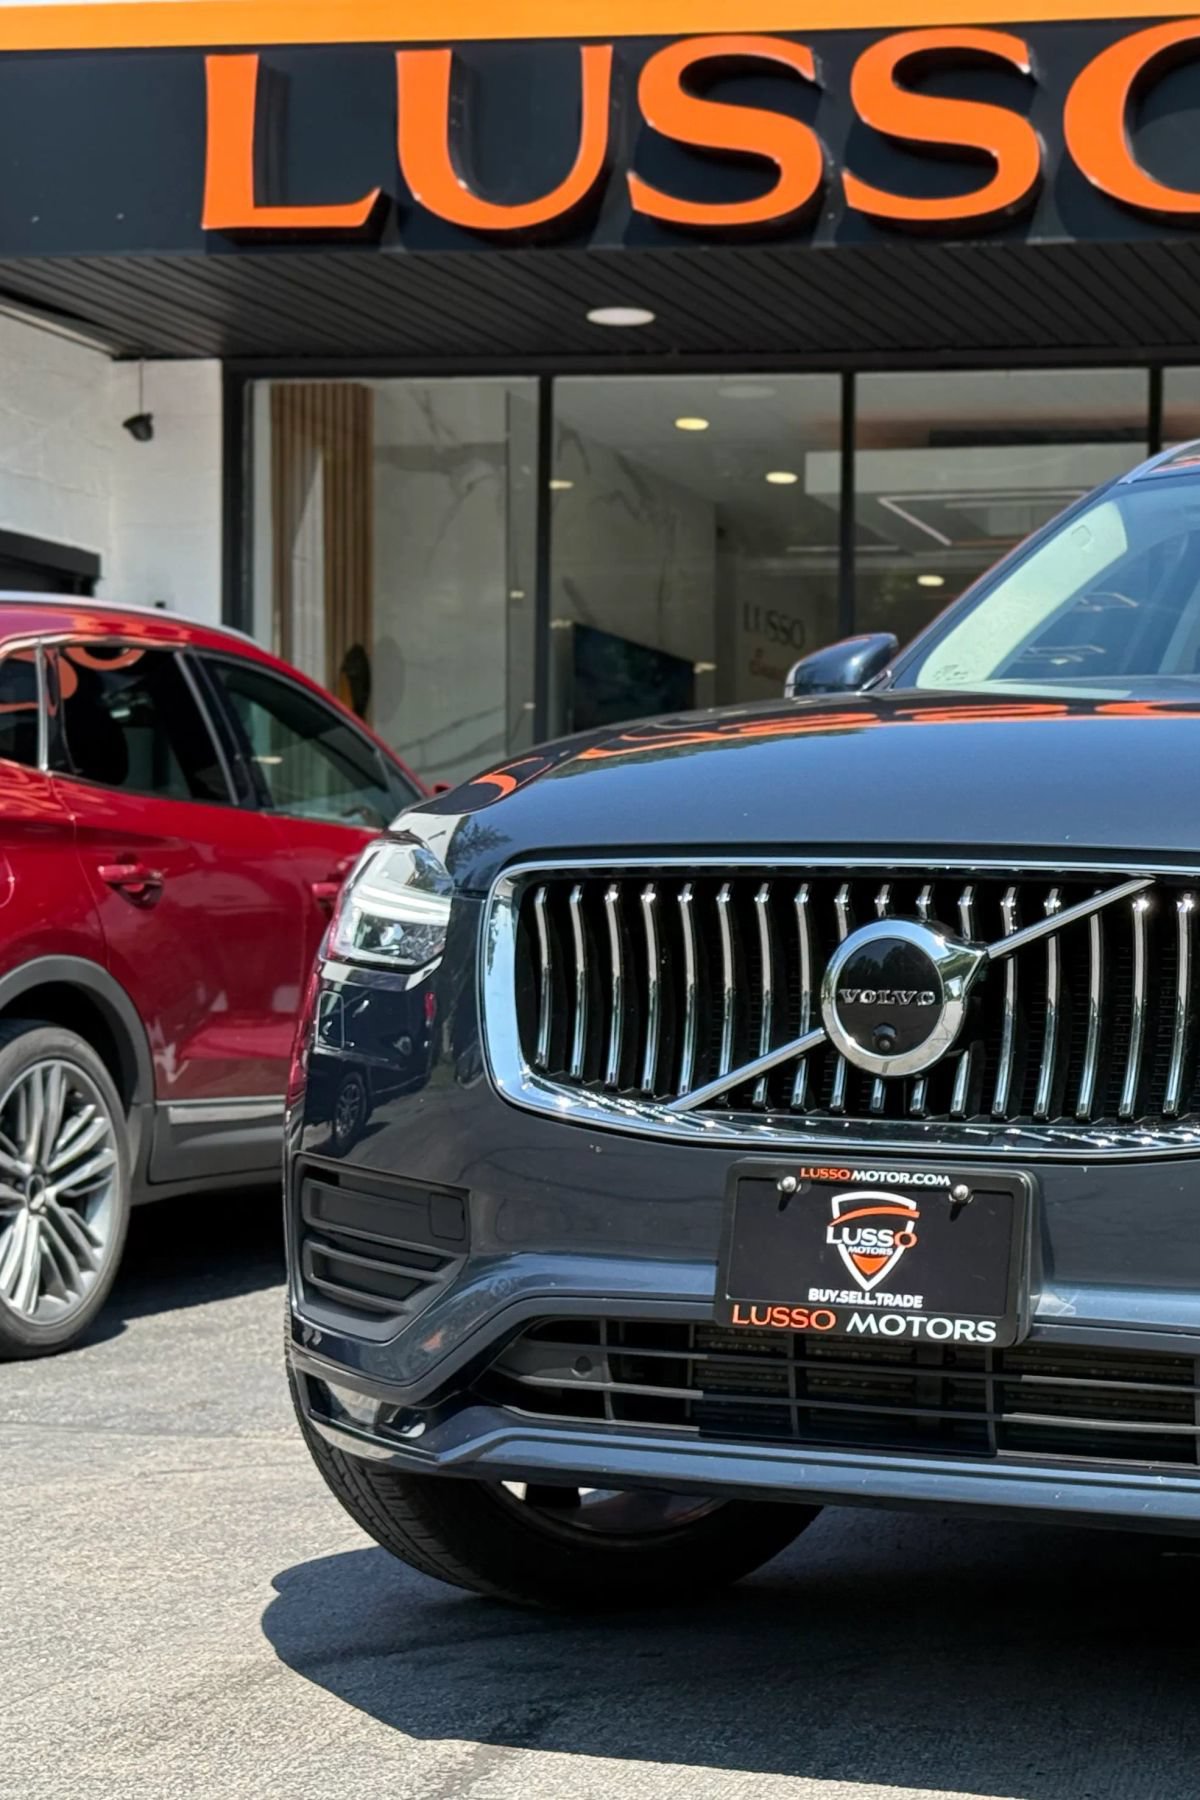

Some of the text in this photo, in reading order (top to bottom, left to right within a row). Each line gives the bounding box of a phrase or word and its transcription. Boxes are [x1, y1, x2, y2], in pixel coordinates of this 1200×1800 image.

[838, 988, 936, 1006] VOLVO
[800, 1167, 951, 1186] LUSSOMOTOR.COM
[826, 1225, 918, 1249] LUSSO
[847, 1245, 894, 1256] MOTORS
[731, 1304, 997, 1343] LUSSO MOTORS
